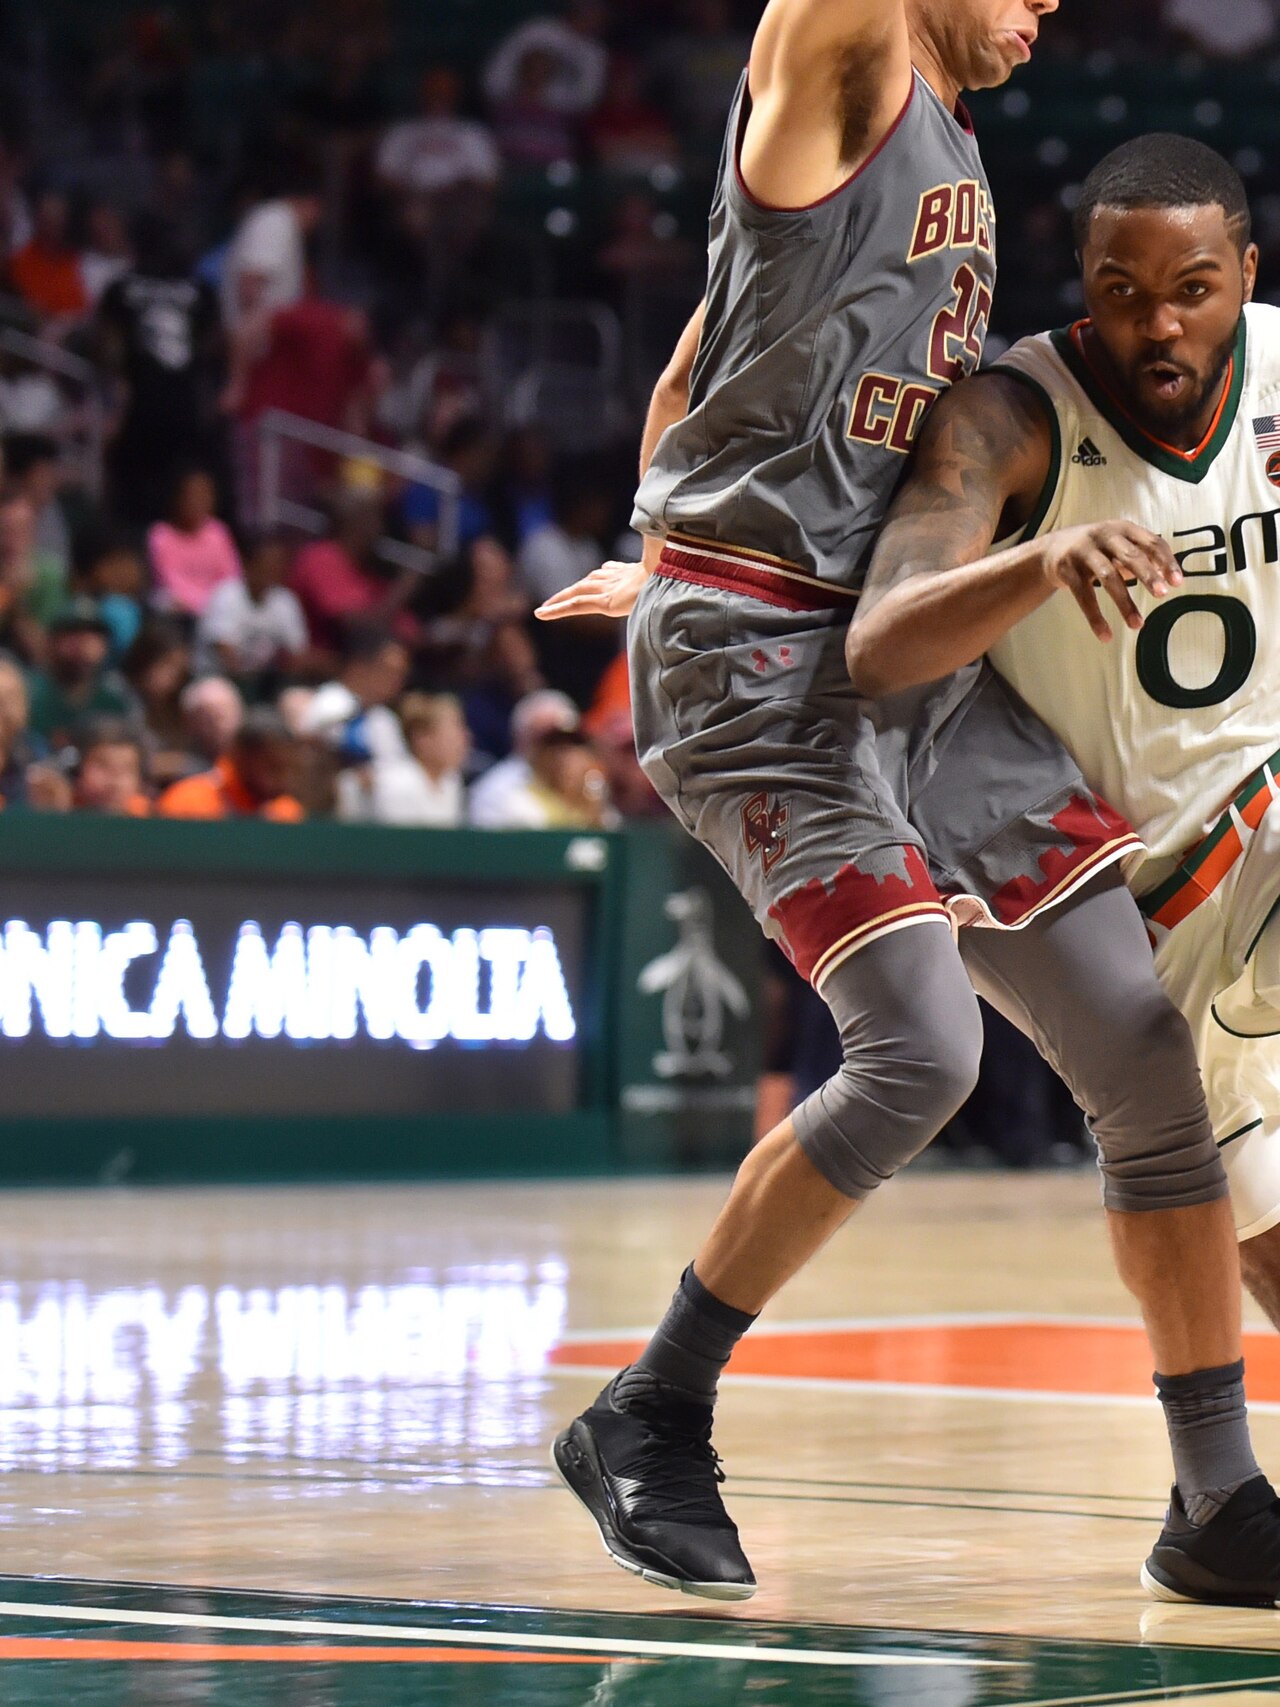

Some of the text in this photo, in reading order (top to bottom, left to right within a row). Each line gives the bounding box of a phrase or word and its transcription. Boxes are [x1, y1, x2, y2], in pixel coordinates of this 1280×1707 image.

[907, 179, 996, 263] BOS
[1136, 594, 1256, 708] 0
[0, 918, 576, 1048] NICA MINOLTA
